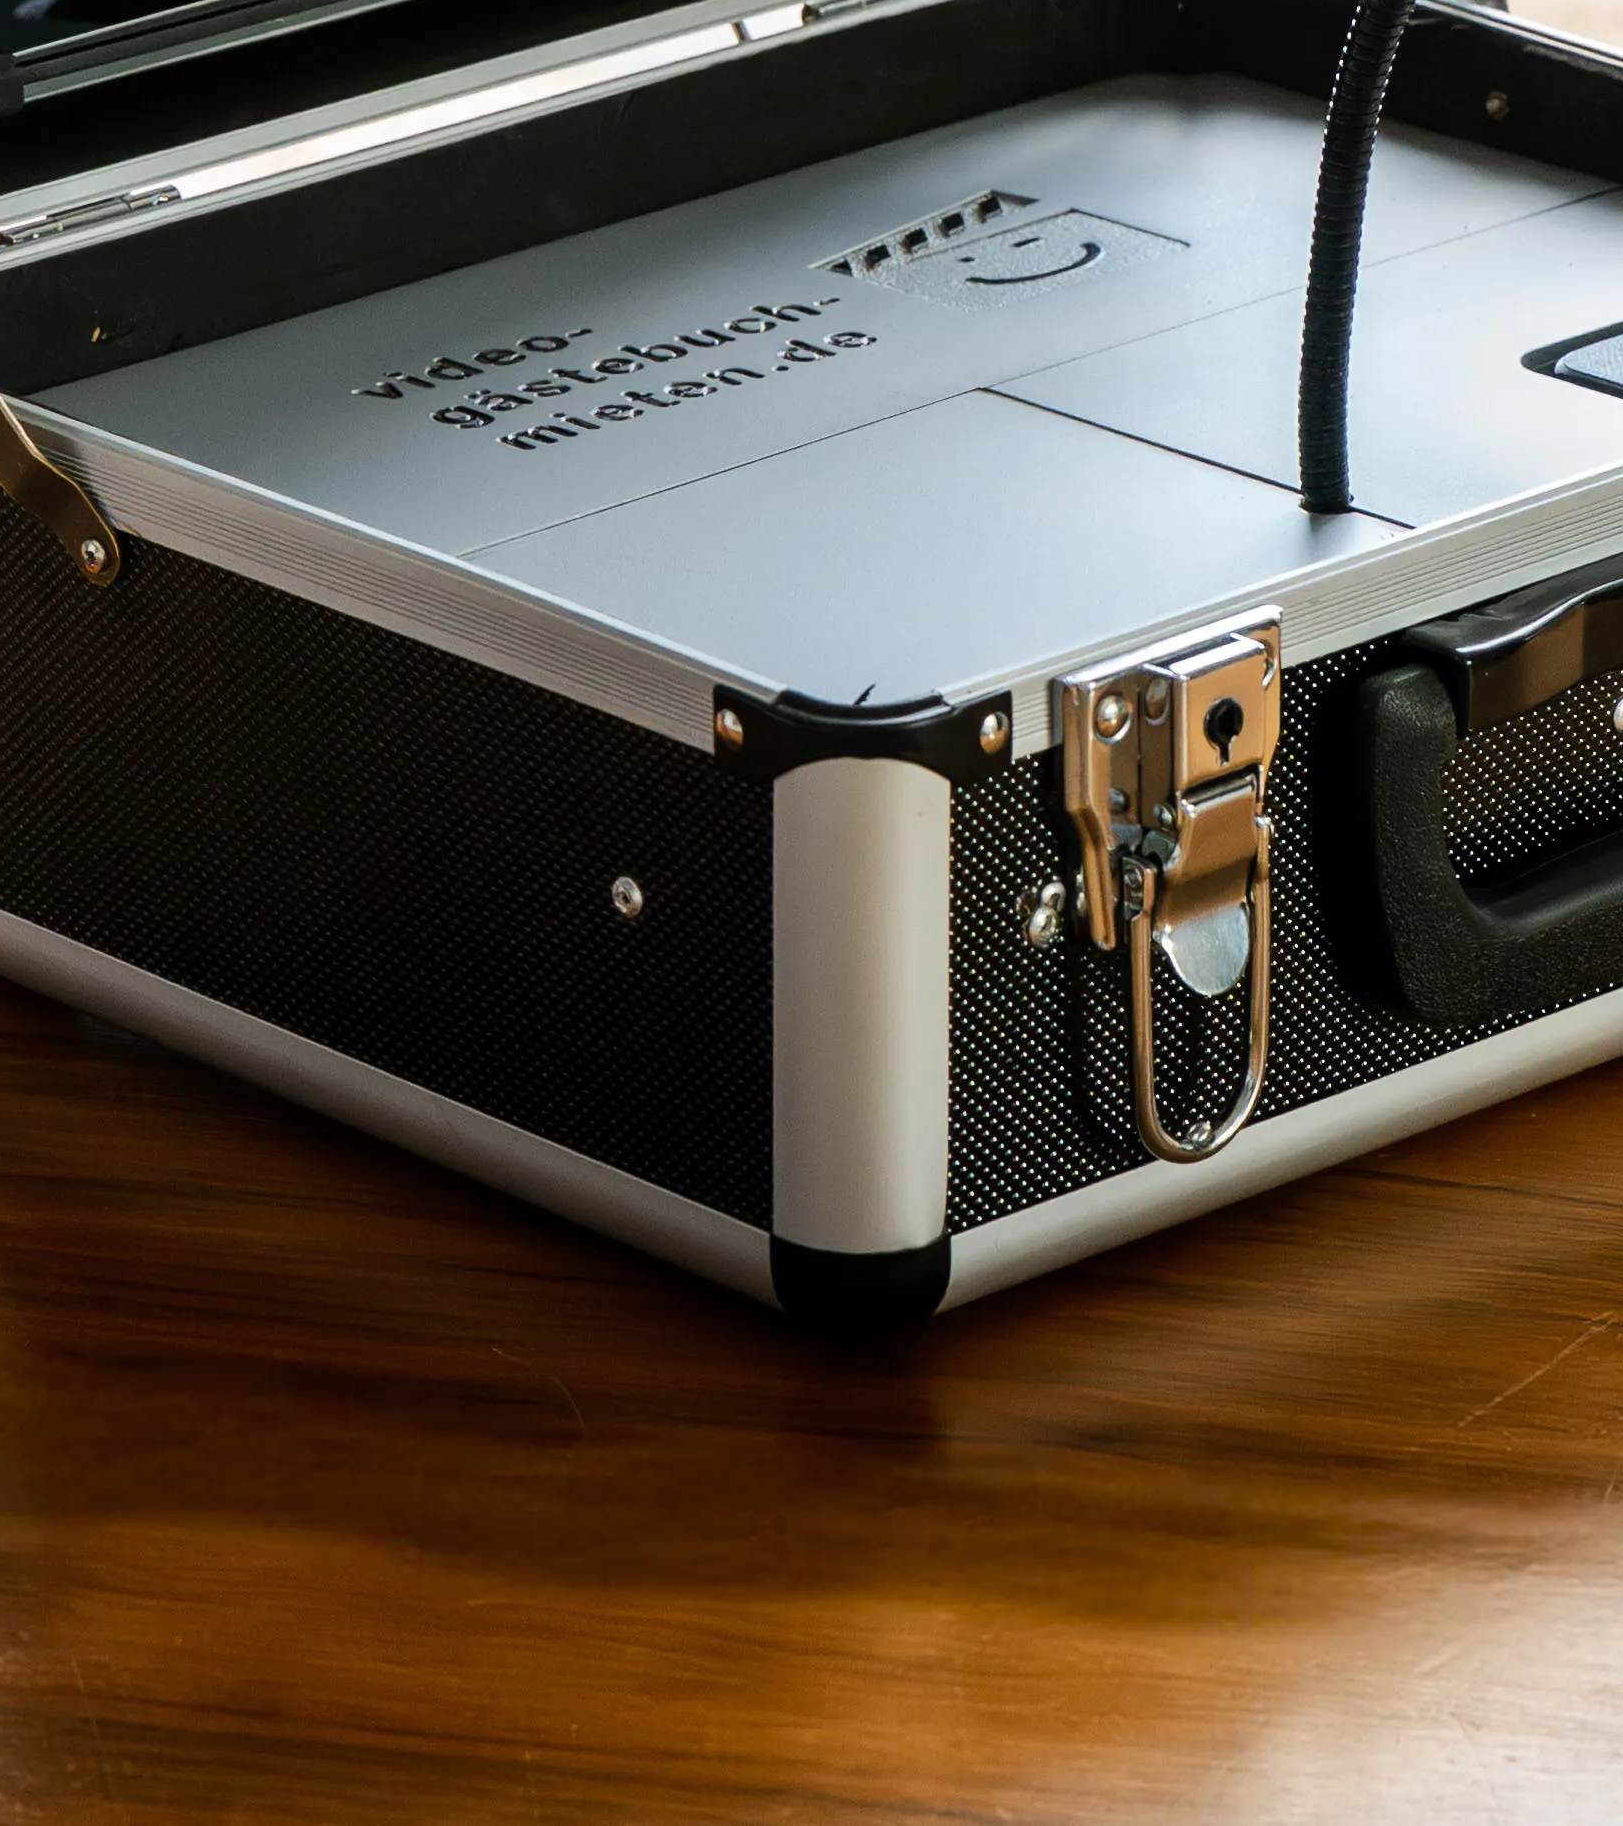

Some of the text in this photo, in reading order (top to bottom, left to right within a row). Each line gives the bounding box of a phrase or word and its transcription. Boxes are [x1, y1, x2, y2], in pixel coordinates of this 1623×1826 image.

[352, 328, 593, 399] video-
[430, 297, 841, 429] gästebuch-
[496, 332, 877, 451] mieten.de
